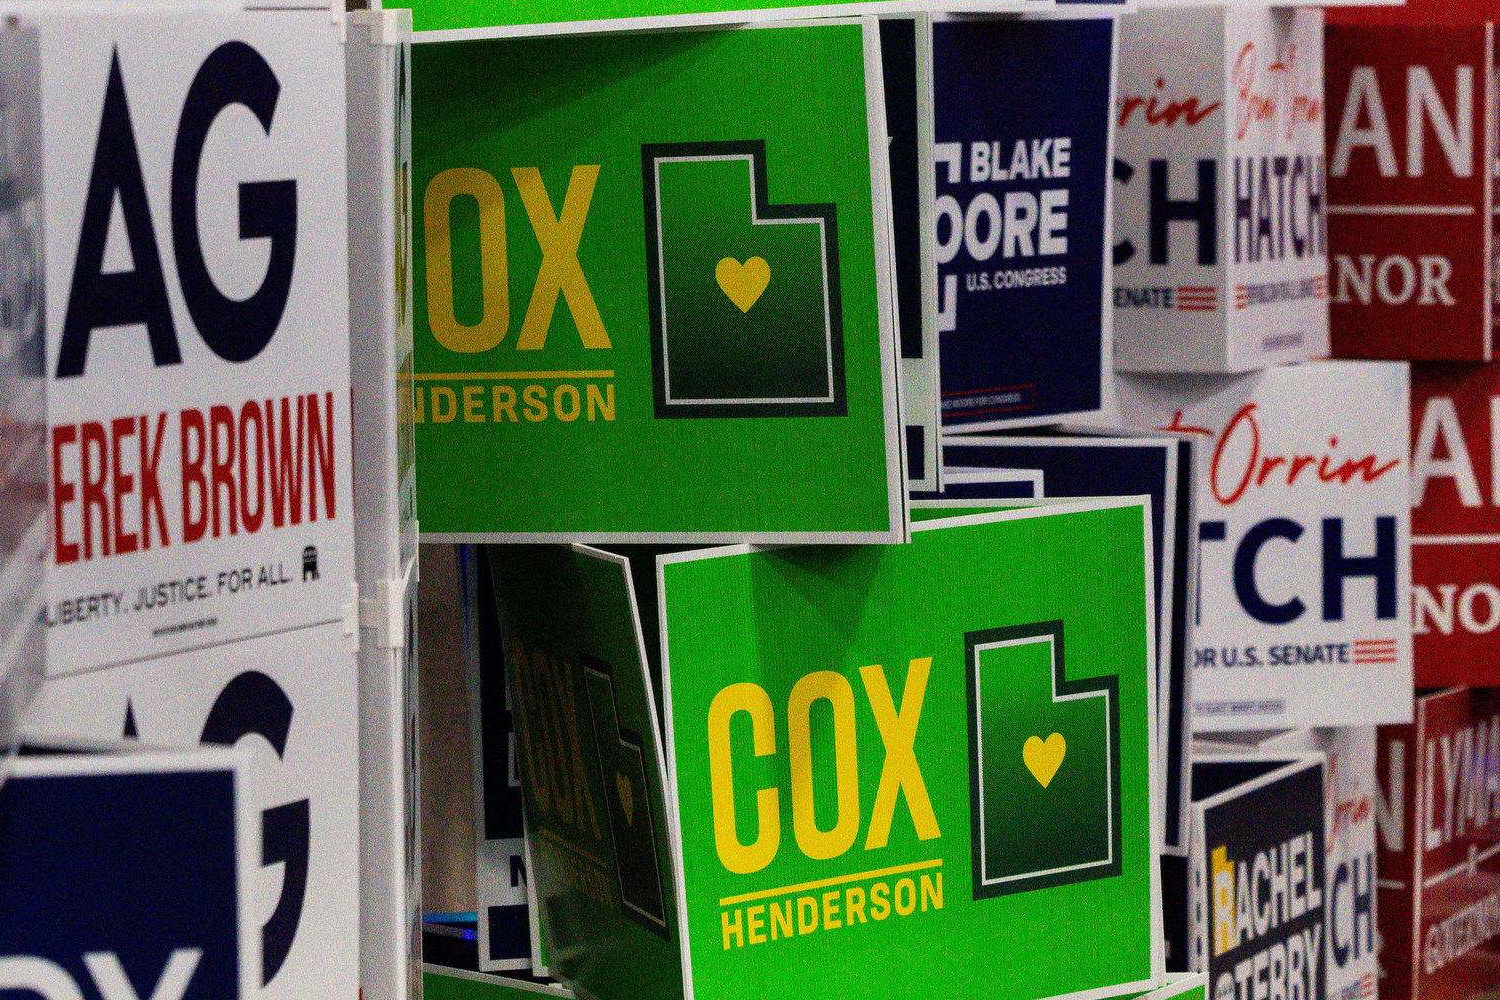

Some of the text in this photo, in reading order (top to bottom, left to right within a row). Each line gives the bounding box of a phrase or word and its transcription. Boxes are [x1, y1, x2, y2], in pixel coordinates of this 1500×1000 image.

[1118, 77, 1222, 127] rin
[970, 136, 1072, 183] BLAKE
[55, 39, 298, 379] AG
[934, 188, 1069, 264] OORE
[1235, 154, 1324, 264] HATCH
[423, 164, 613, 355] OX
[965, 266, 1067, 292] U.S. CONGRESS
[1113, 285, 1176, 310] ENATE
[414, 383, 616, 424] DERSON
[52, 392, 336, 566] EREK BROWN
[1211, 403, 1401, 505] Orrin
[133, 576, 211, 612] JUSTICE.
[217, 568, 252, 596] FOR
[257, 560, 293, 588] ALL.
[1221, 646, 1263, 668] U.S.
[1268, 642, 1349, 667] SENATE
[707, 657, 942, 876] COX
[720, 872, 945, 951] HENDERSON
[1211, 832, 1323, 958] RACHEL
